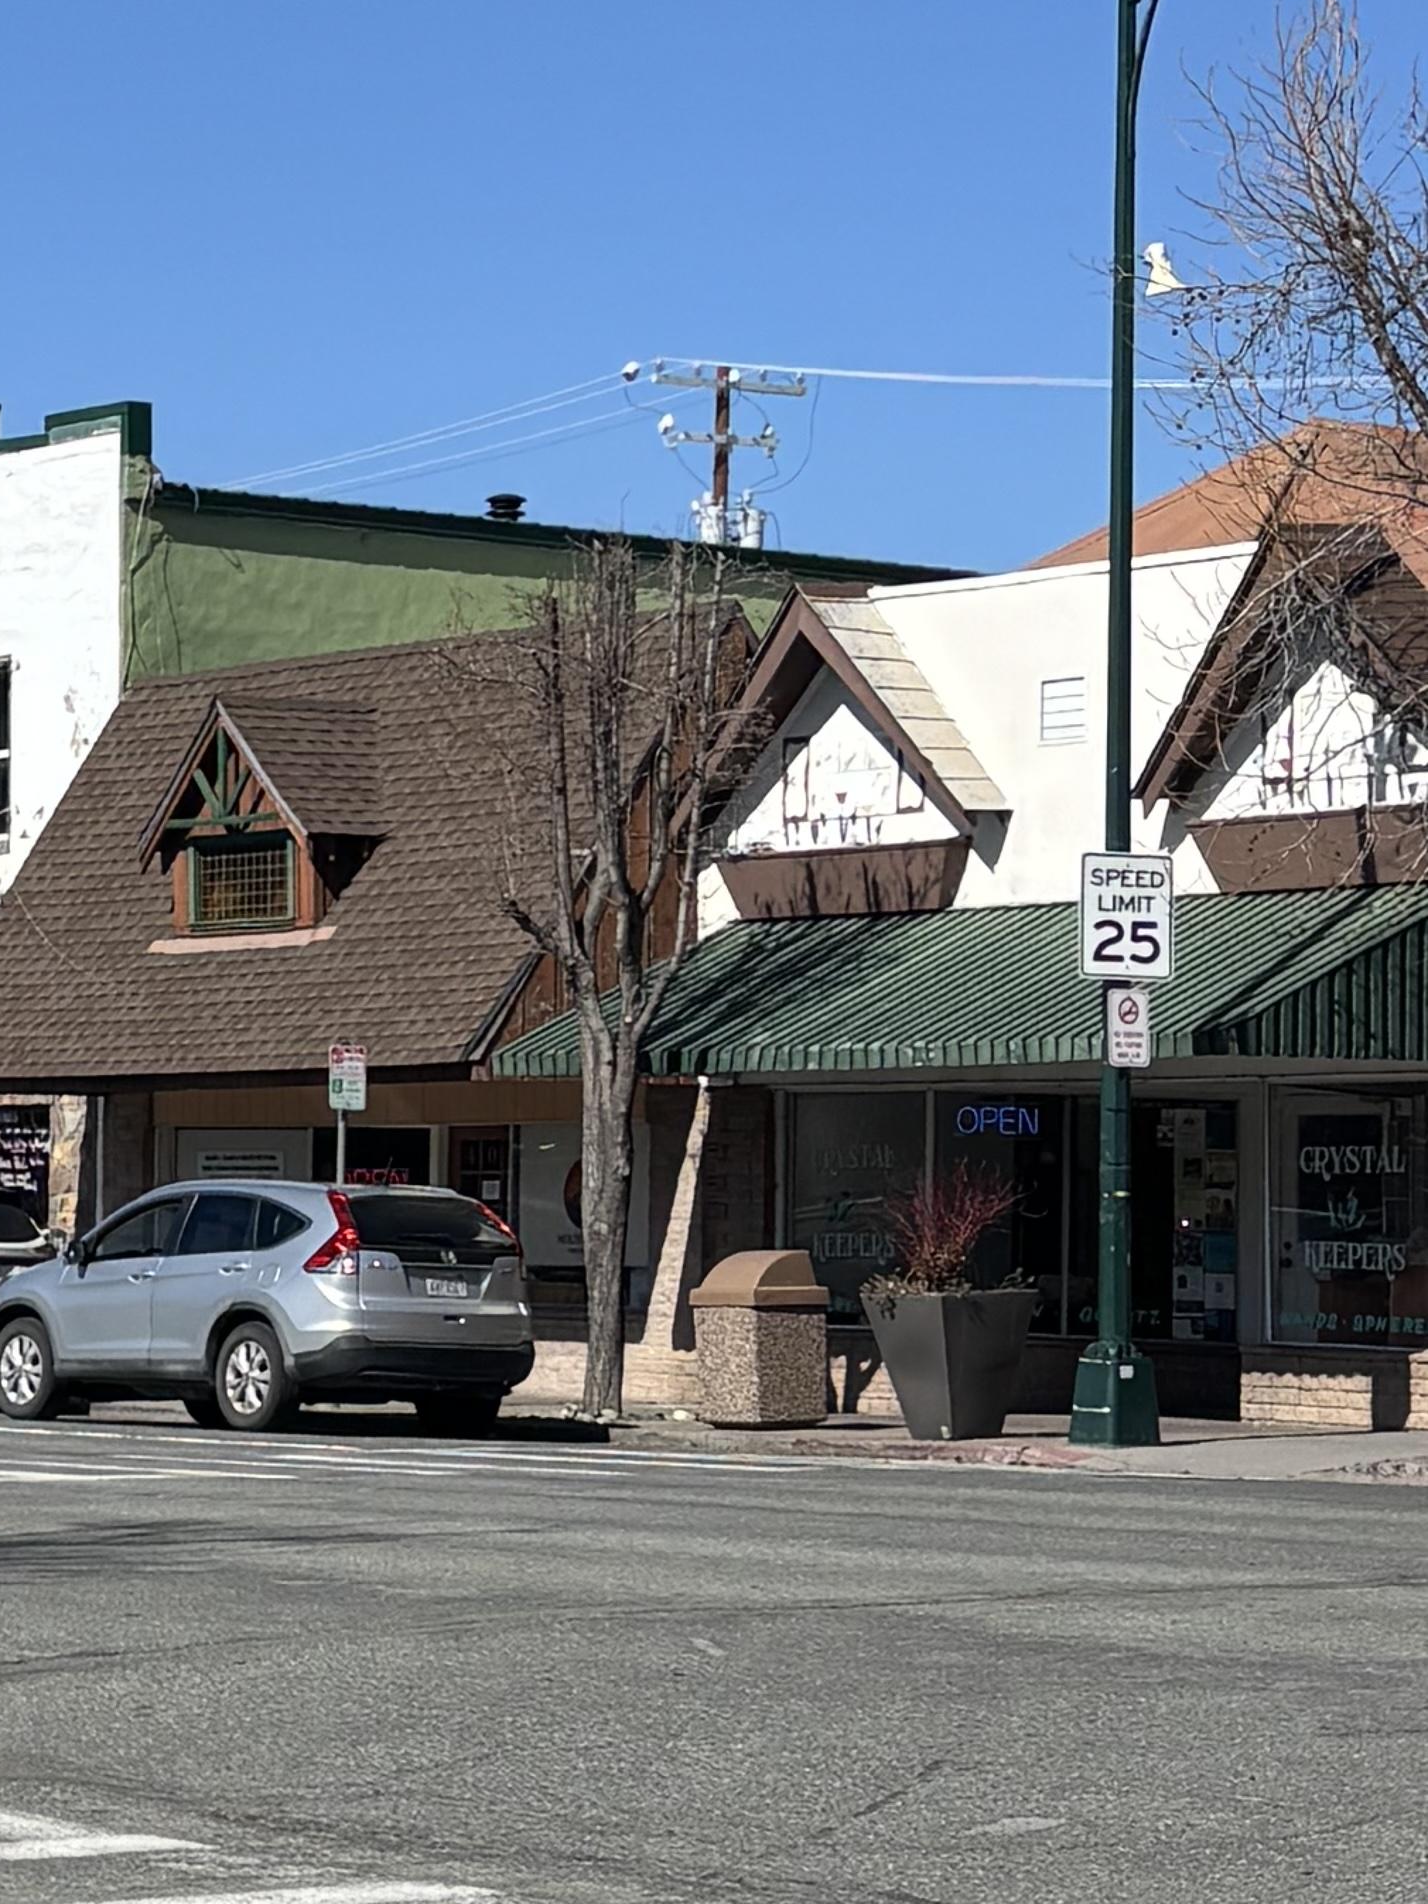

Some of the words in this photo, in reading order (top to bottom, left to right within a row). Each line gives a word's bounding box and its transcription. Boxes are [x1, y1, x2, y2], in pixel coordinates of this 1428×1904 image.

[1090, 868, 1165, 889] SPEED
[1098, 893, 1156, 913] LIMIT
[1093, 919, 1161, 964] 25
[956, 1105, 1039, 1135] OPEN
[1299, 1145, 1406, 1181] CRYSTAL
[1304, 1240, 1407, 1281] KEEPERS
